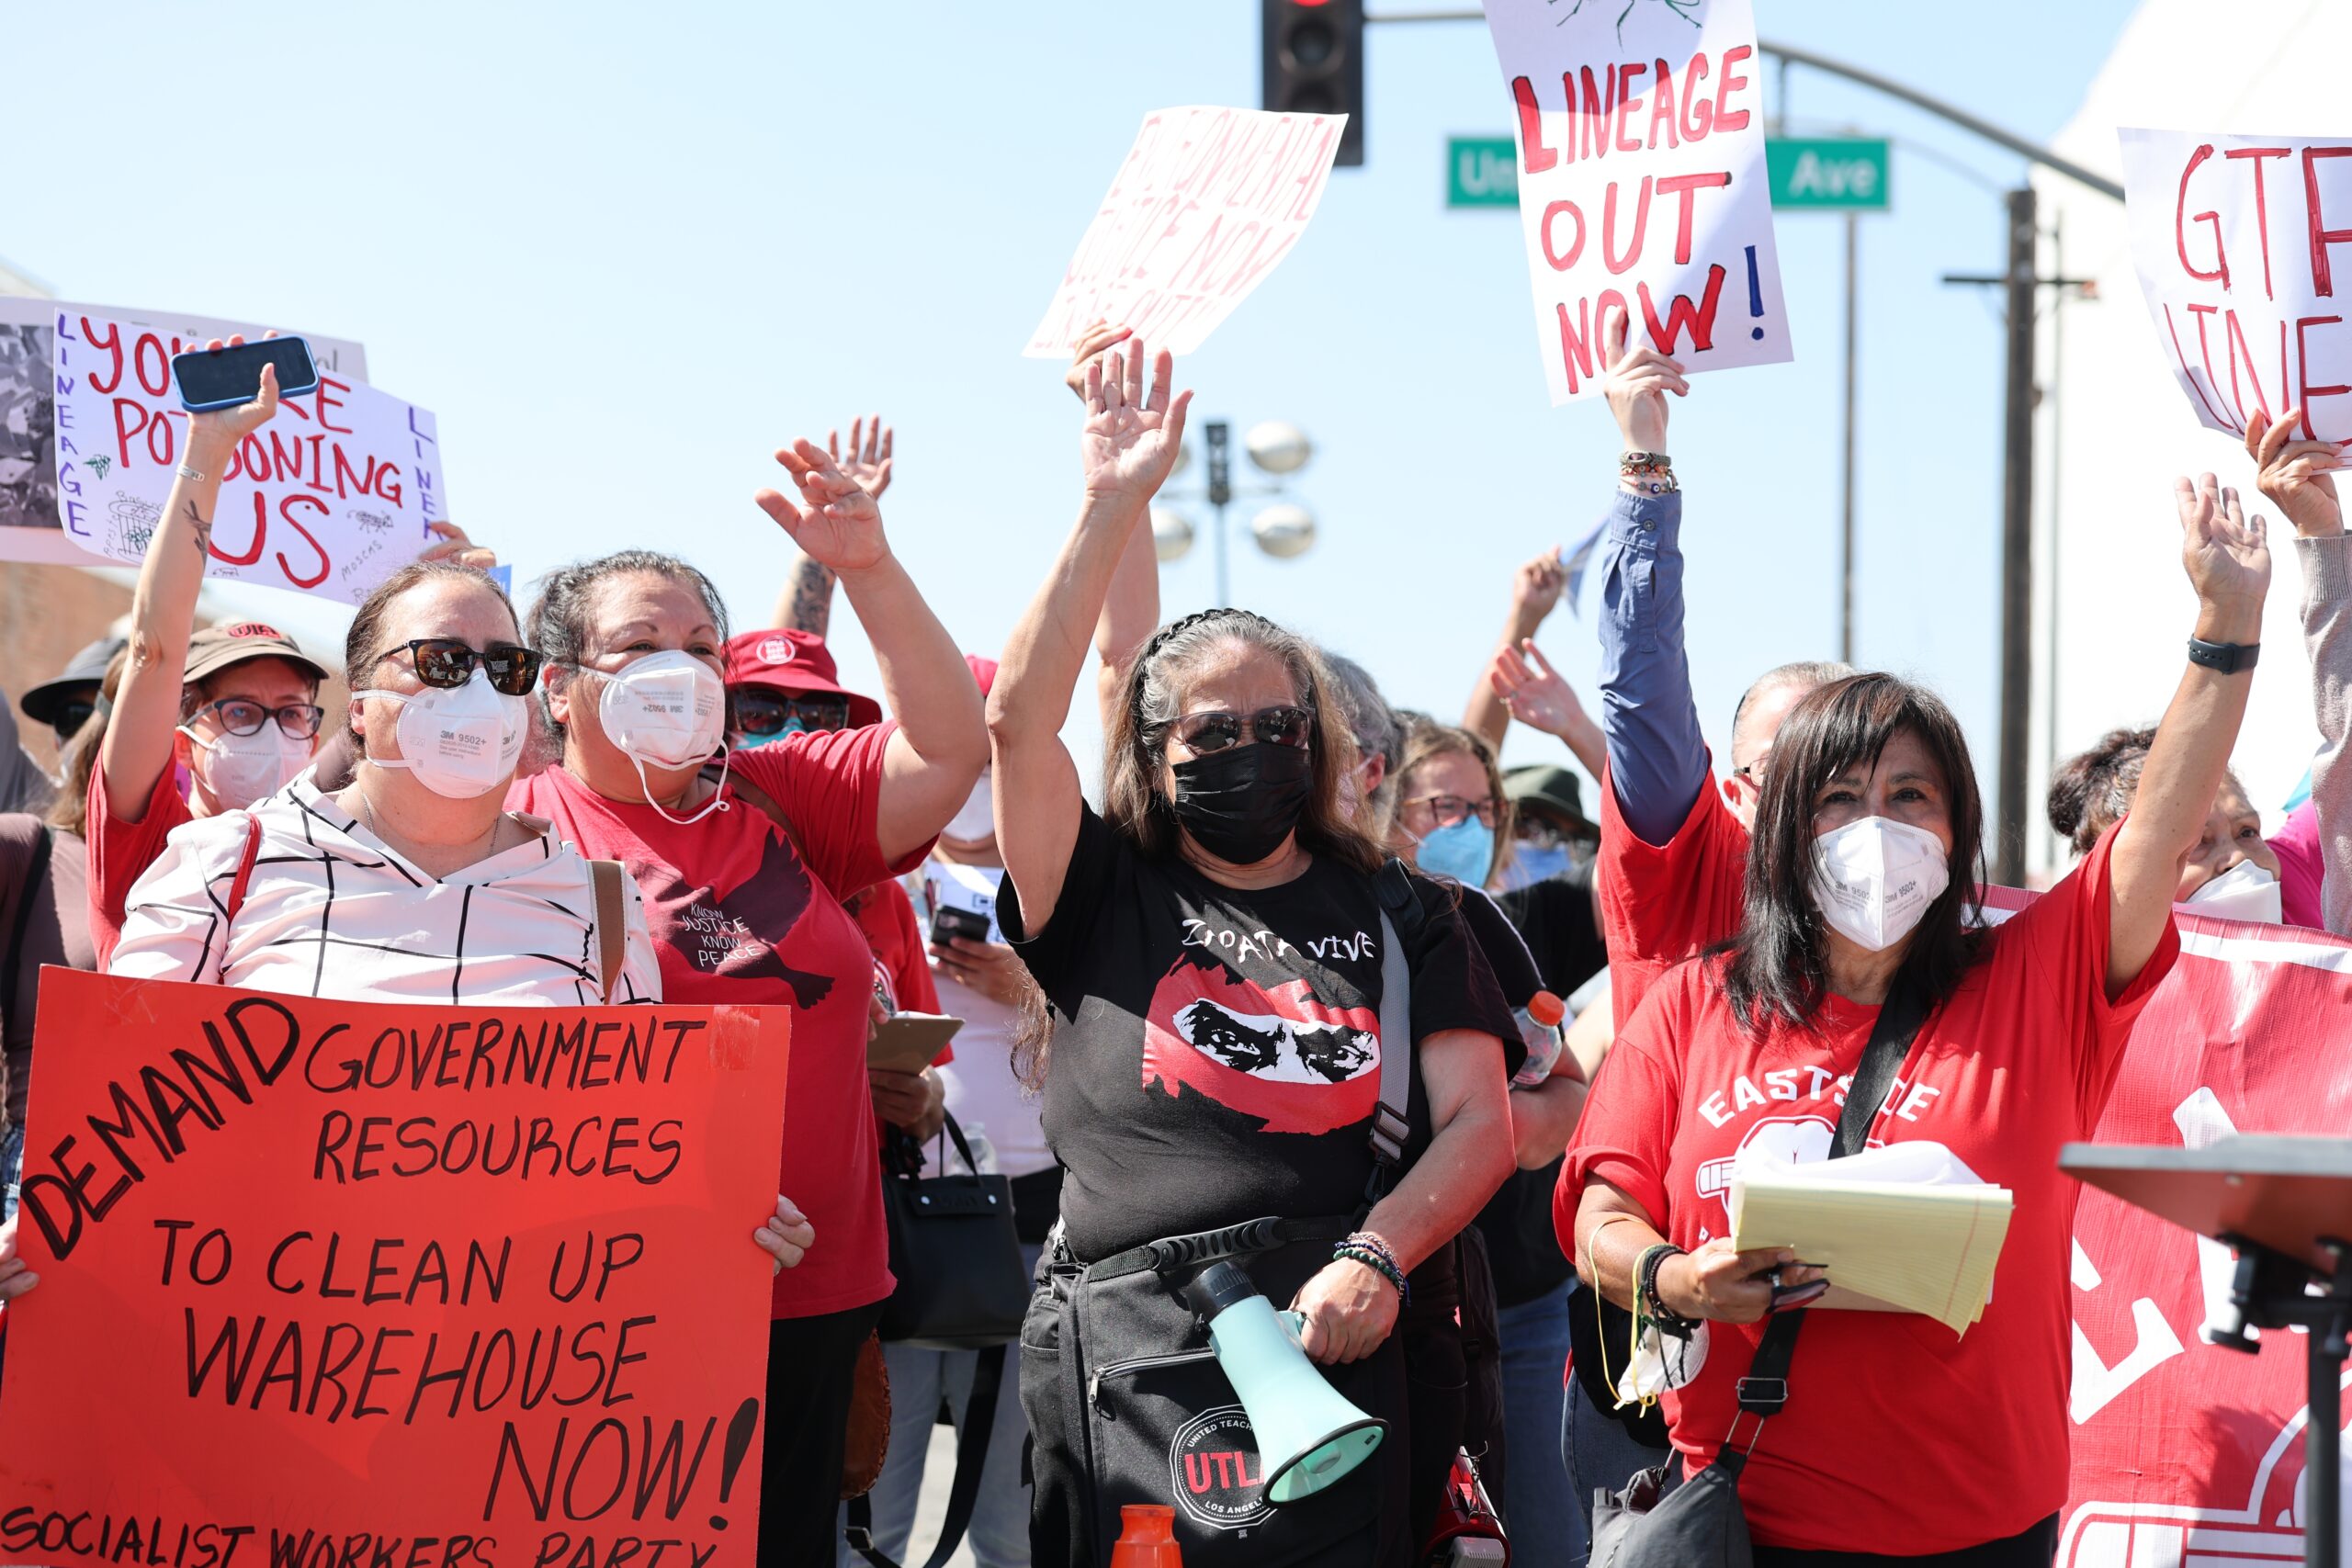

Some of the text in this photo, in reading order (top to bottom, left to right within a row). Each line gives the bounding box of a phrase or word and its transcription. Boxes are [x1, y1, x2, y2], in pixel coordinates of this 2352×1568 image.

[1512, 45, 1751, 174] LINEAGE
[1787, 148, 1879, 197] Ave
[1541, 171, 1733, 275] OUT
[81, 317, 353, 434] YOE
[57, 314, 92, 537] LINEAGE
[113, 399, 402, 508] POONING
[209, 491, 331, 589] US
[440, 730, 454, 740] 3M
[458, 733, 487, 745] 9502+
[683, 915, 750, 935] JUSTICE
[691, 901, 724, 920] KNOW
[701, 935, 741, 950] KNOW
[698, 944, 761, 967] PEACE
[1307, 931, 1376, 962] VIVE
[21, 997, 707, 1261] DEMAND GOVERNMENT
[1698, 1065, 1940, 1129] EASTSDE
[313, 1110, 684, 1185] RESOURCES
[153, 1220, 644, 1306] TO CLEAN UP
[185, 1306, 657, 1426] WAREHOUSE
[483, 1397, 760, 1531] NOW!
[1187, 1419, 1254, 1449] UNITED TEACH
[1, 1506, 718, 1568] SOCIALIST WORKERS PARTY
[1204, 1496, 1264, 1514] LOS ANGEL
